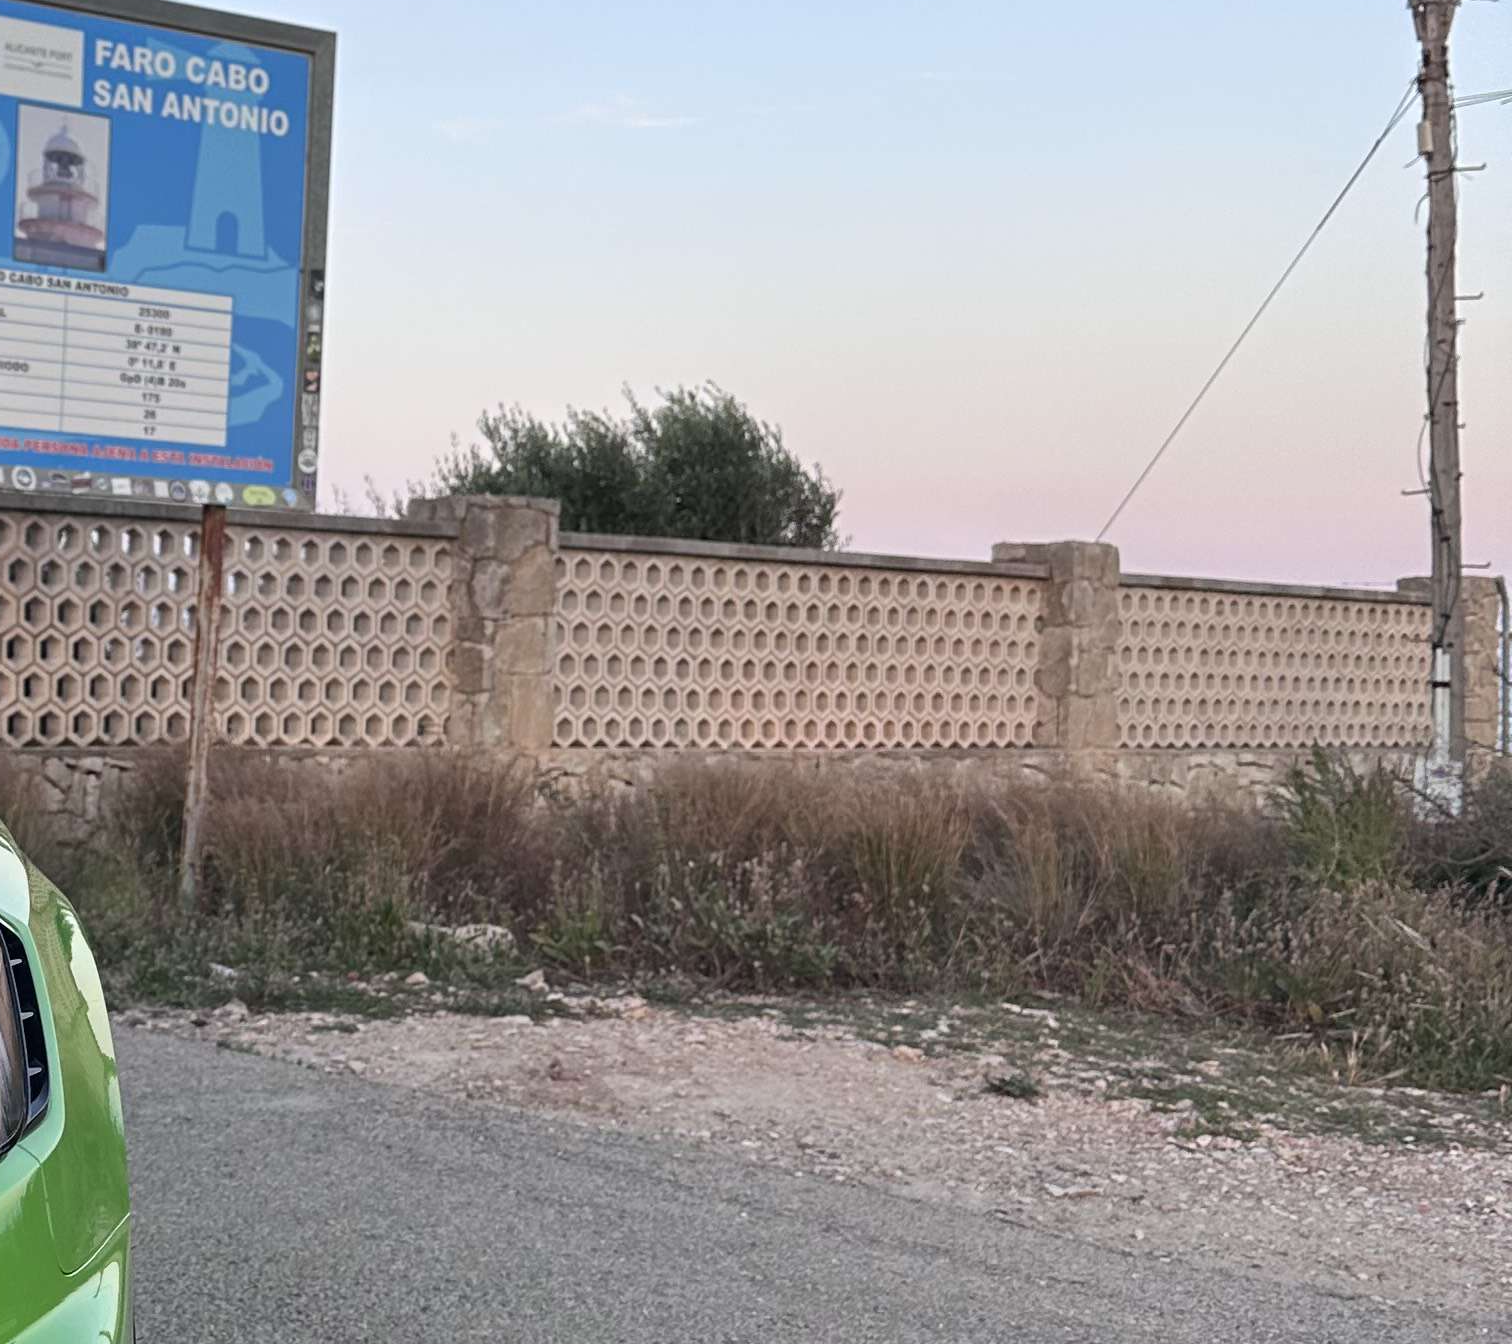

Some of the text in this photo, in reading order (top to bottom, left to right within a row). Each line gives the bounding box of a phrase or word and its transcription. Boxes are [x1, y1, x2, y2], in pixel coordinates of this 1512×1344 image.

[94, 39, 176, 79] FARO
[186, 56, 270, 95] CABO
[93, 79, 289, 137] SAN ANTONIO
[9, 271, 44, 286] CABO
[47, 277, 72, 289] SAN
[75, 281, 130, 297] ANTONIO
[24, 439, 88, 456] PERSONA
[92, 444, 136, 460] AJENA
